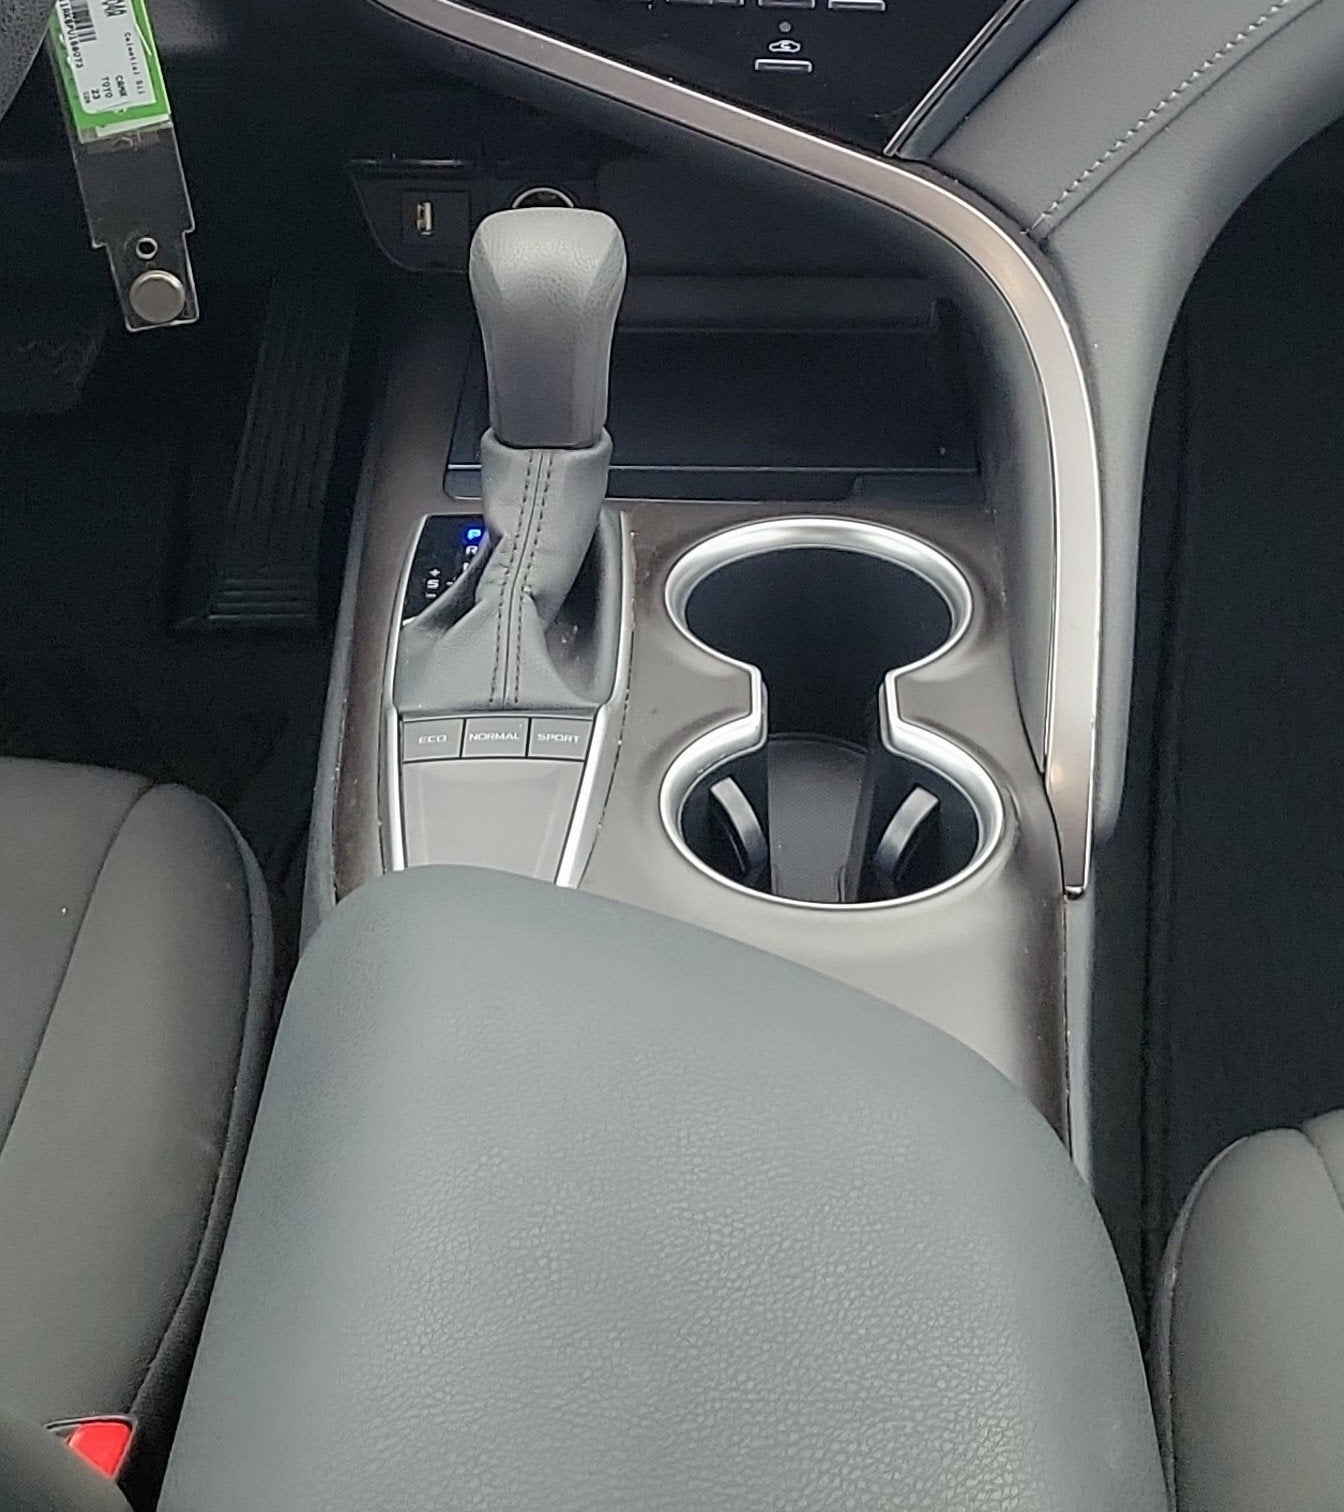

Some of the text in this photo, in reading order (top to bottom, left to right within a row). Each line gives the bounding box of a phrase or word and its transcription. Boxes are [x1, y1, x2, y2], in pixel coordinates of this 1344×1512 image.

[101, 76, 114, 99] TOYO
[467, 529, 482, 540] P
[466, 546, 478, 555] R
[427, 579, 439, 589] S
[418, 734, 447, 744] ECO
[469, 732, 521, 741] NORMAL
[537, 732, 579, 743] SPORT
